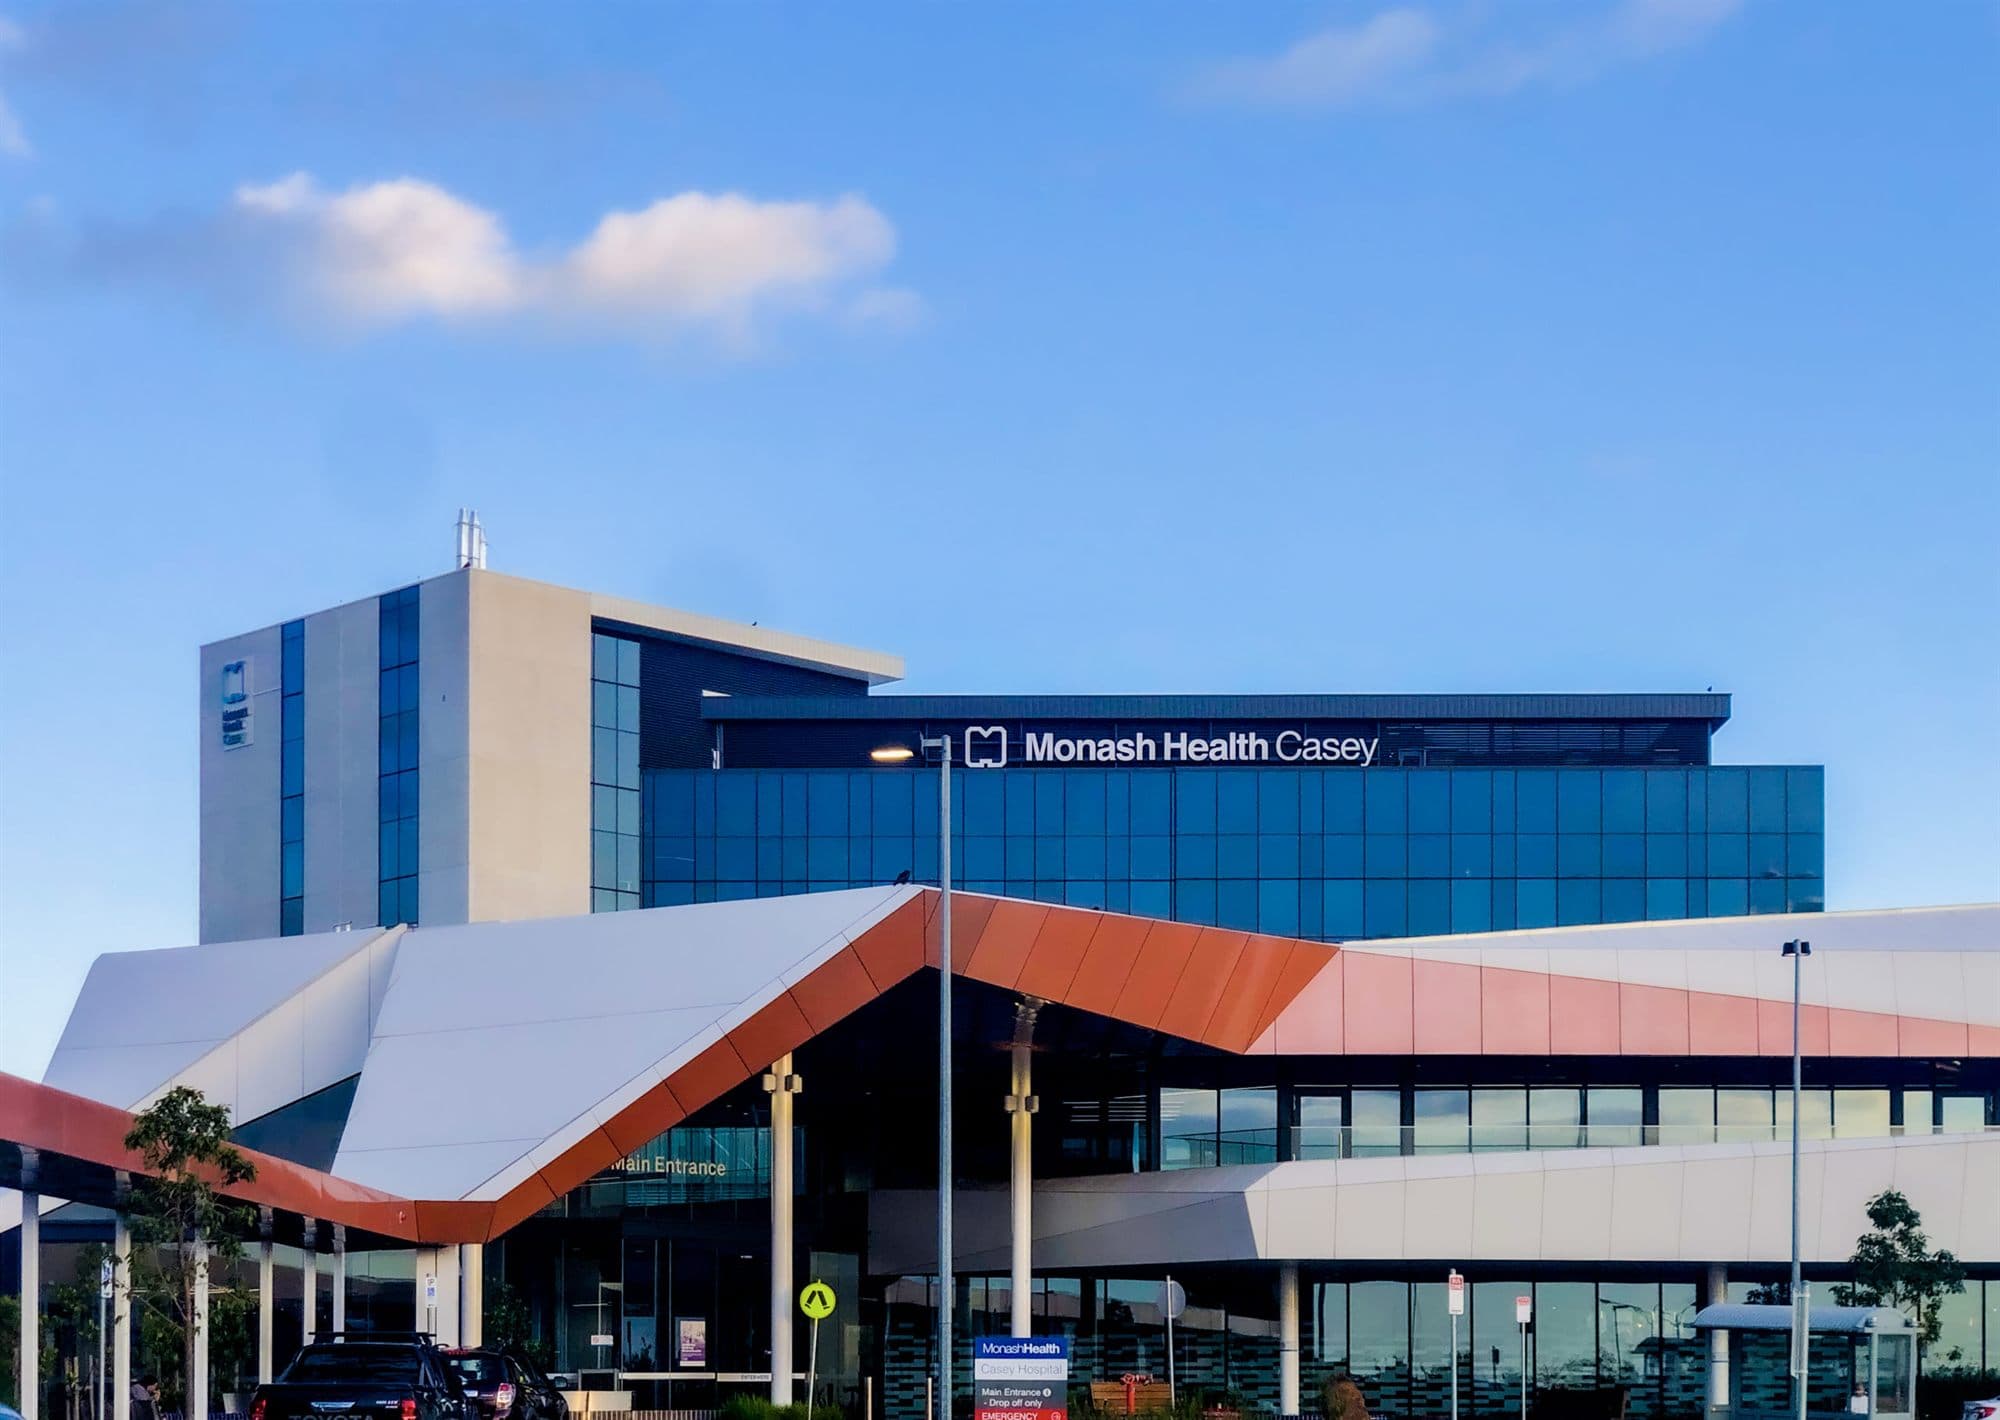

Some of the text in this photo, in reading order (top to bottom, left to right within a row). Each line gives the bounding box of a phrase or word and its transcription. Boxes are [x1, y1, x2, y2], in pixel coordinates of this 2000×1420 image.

[1025, 730, 1379, 767] Monash Health Casey
[655, 1156, 726, 1176] Entrance
[982, 1343, 1060, 1354] MonashHealth
[981, 1363, 1062, 1376] Casey Hospital
[981, 1388, 1041, 1397] Main Entrance
[989, 1399, 1010, 1408] Drop
[1011, 1399, 1024, 1407] off
[1025, 1400, 1043, 1409] only
[981, 1412, 1038, 1420] EMERGENCY
